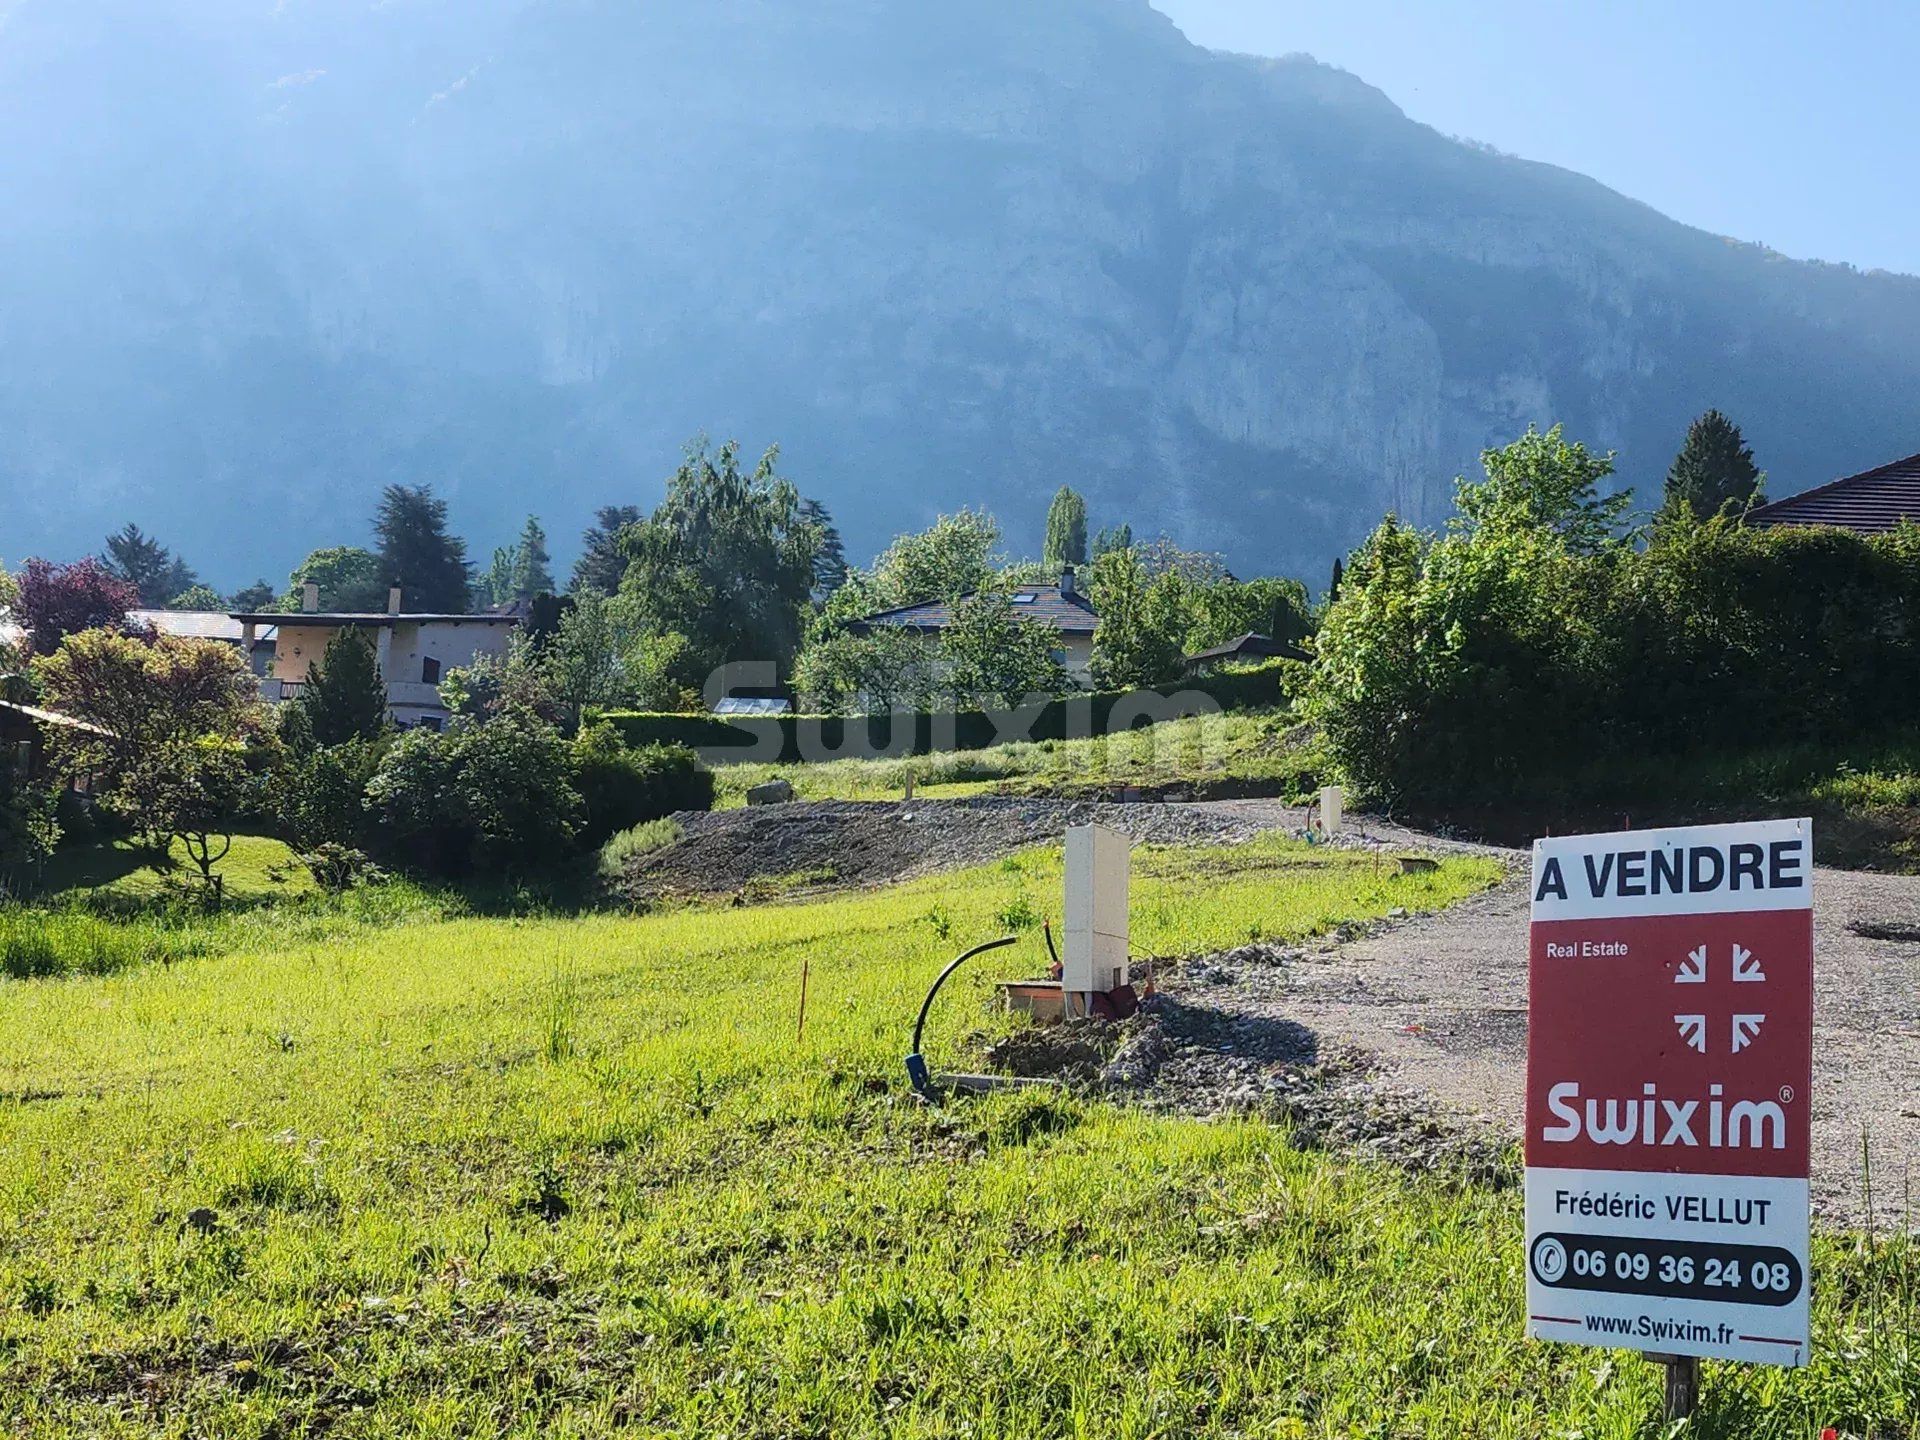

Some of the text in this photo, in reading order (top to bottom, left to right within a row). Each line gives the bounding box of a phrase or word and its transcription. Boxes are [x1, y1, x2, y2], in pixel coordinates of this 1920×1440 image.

[1535, 840, 1804, 901] A VENDRE
[1547, 941, 1629, 958] Real Estate
[1555, 1190, 1771, 1225] Frédéric VELLUT
[1573, 1249, 1791, 1292] 06 09 36 24 08
[1586, 1314, 1734, 1345] www.Swixim.fr
